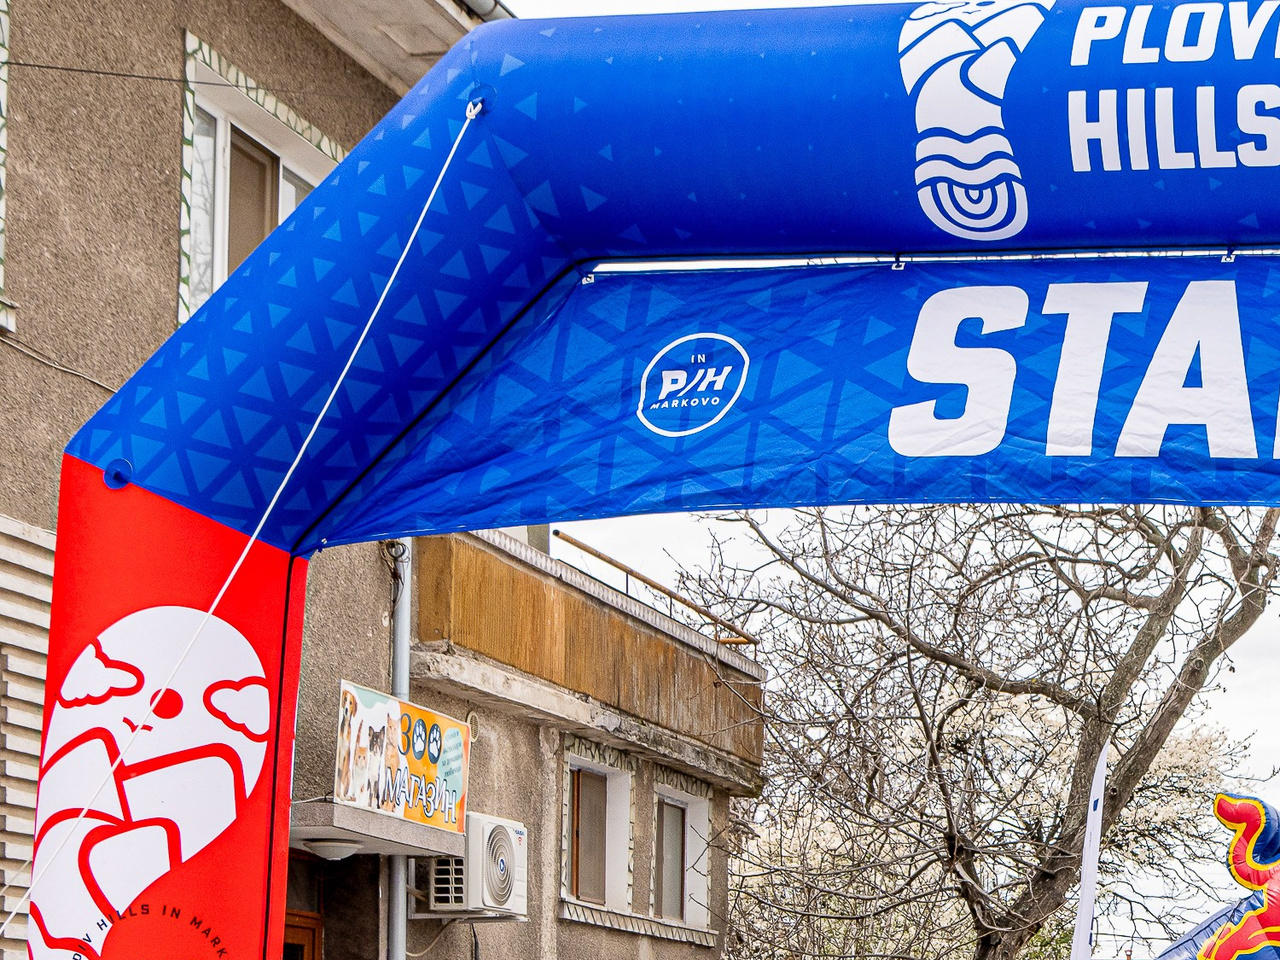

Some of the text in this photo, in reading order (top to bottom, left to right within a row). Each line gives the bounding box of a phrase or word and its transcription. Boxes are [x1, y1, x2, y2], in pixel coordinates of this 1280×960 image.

[691, 354, 706, 363] IN
[658, 366, 733, 400] P/H
[650, 397, 720, 410] MARKOVO
[385, 766, 457, 823] МАГАЗИН
[96, 903, 150, 931] HILLS
[162, 904, 181, 918] IN
